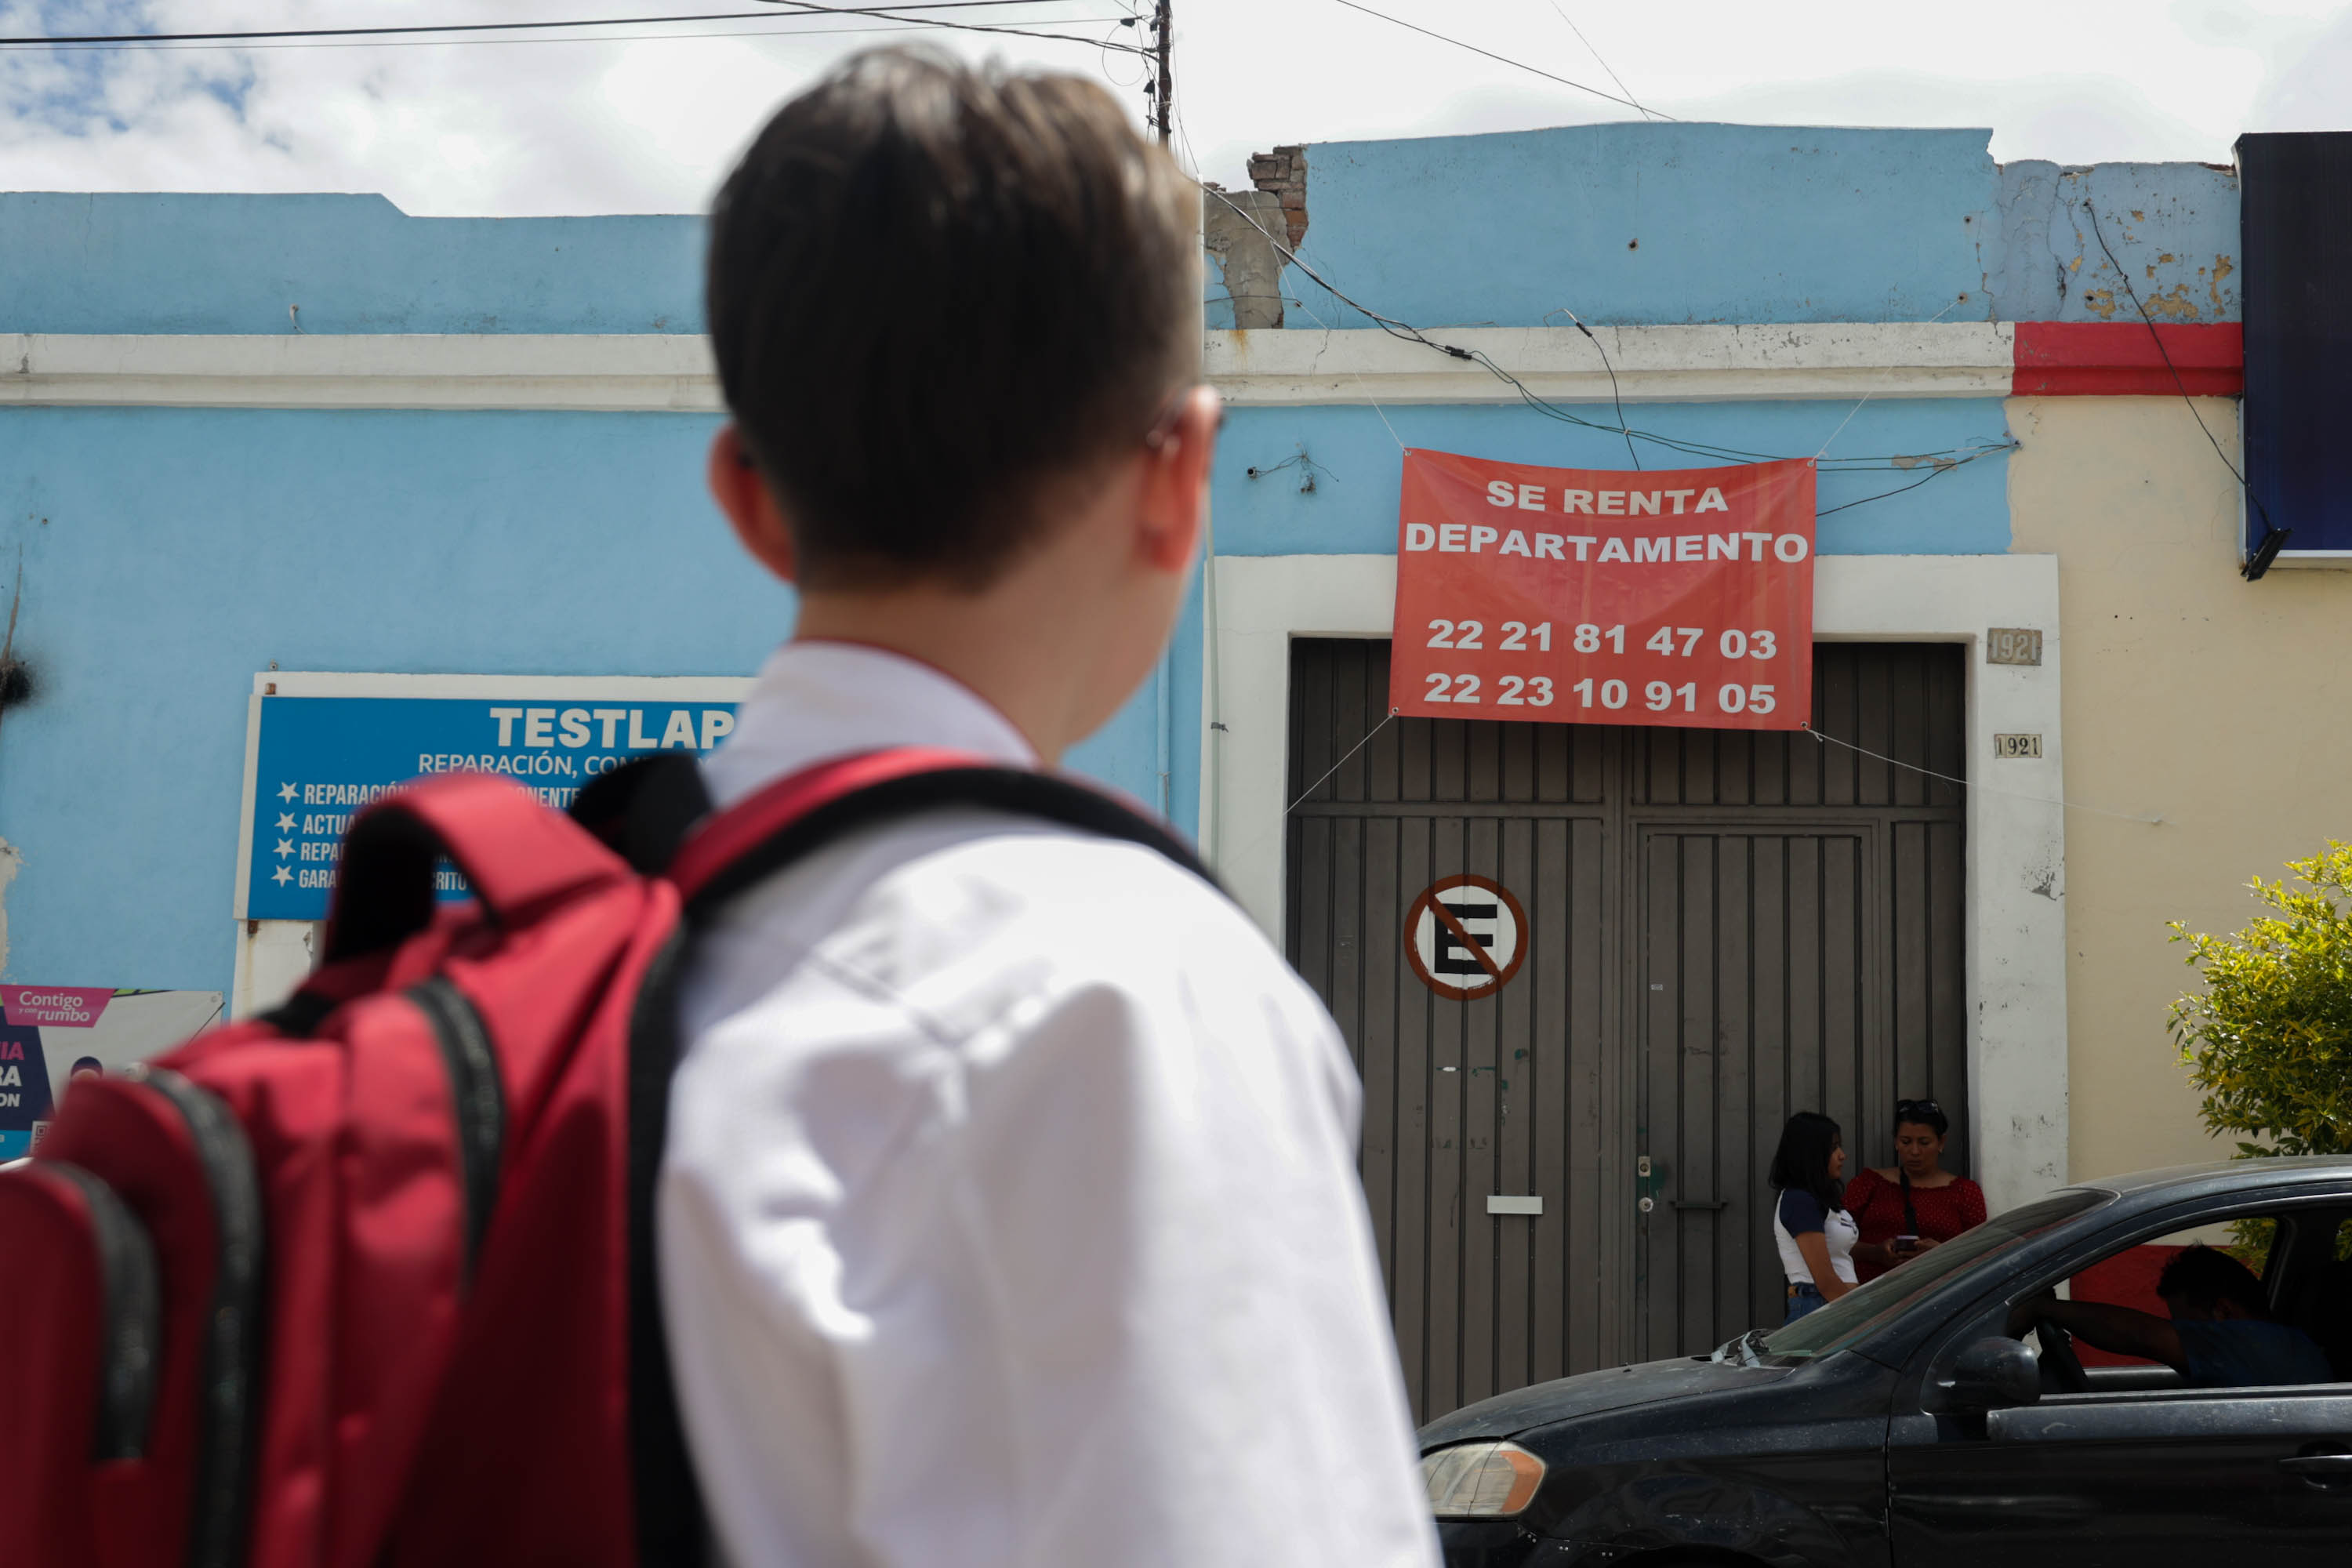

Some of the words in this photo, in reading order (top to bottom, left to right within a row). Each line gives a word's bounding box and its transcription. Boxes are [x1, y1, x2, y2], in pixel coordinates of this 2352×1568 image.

[1486, 480, 1546, 512] SE
[1563, 487, 1729, 516] RENTA
[1405, 522, 1809, 563] DEPARTAMENTO
[1426, 619, 1483, 650] 22
[1499, 621, 1552, 652] 21
[1573, 622, 1625, 655] 81
[1646, 626, 1704, 657] 47
[1719, 629, 1777, 660] 03
[1991, 633, 2038, 660] 1921
[1423, 673, 1481, 703] 22
[1497, 675, 1554, 706] 23
[1573, 677, 1628, 710] 10
[1645, 681, 1696, 712] 91
[1718, 683, 1776, 714] 05
[489, 707, 735, 750] TESTLAP
[1997, 736, 2038, 755] 1921
[419, 750, 578, 779] REPARACIÓN,
[19, 991, 83, 1010] Contigo
[37, 1007, 90, 1022] rumbo
